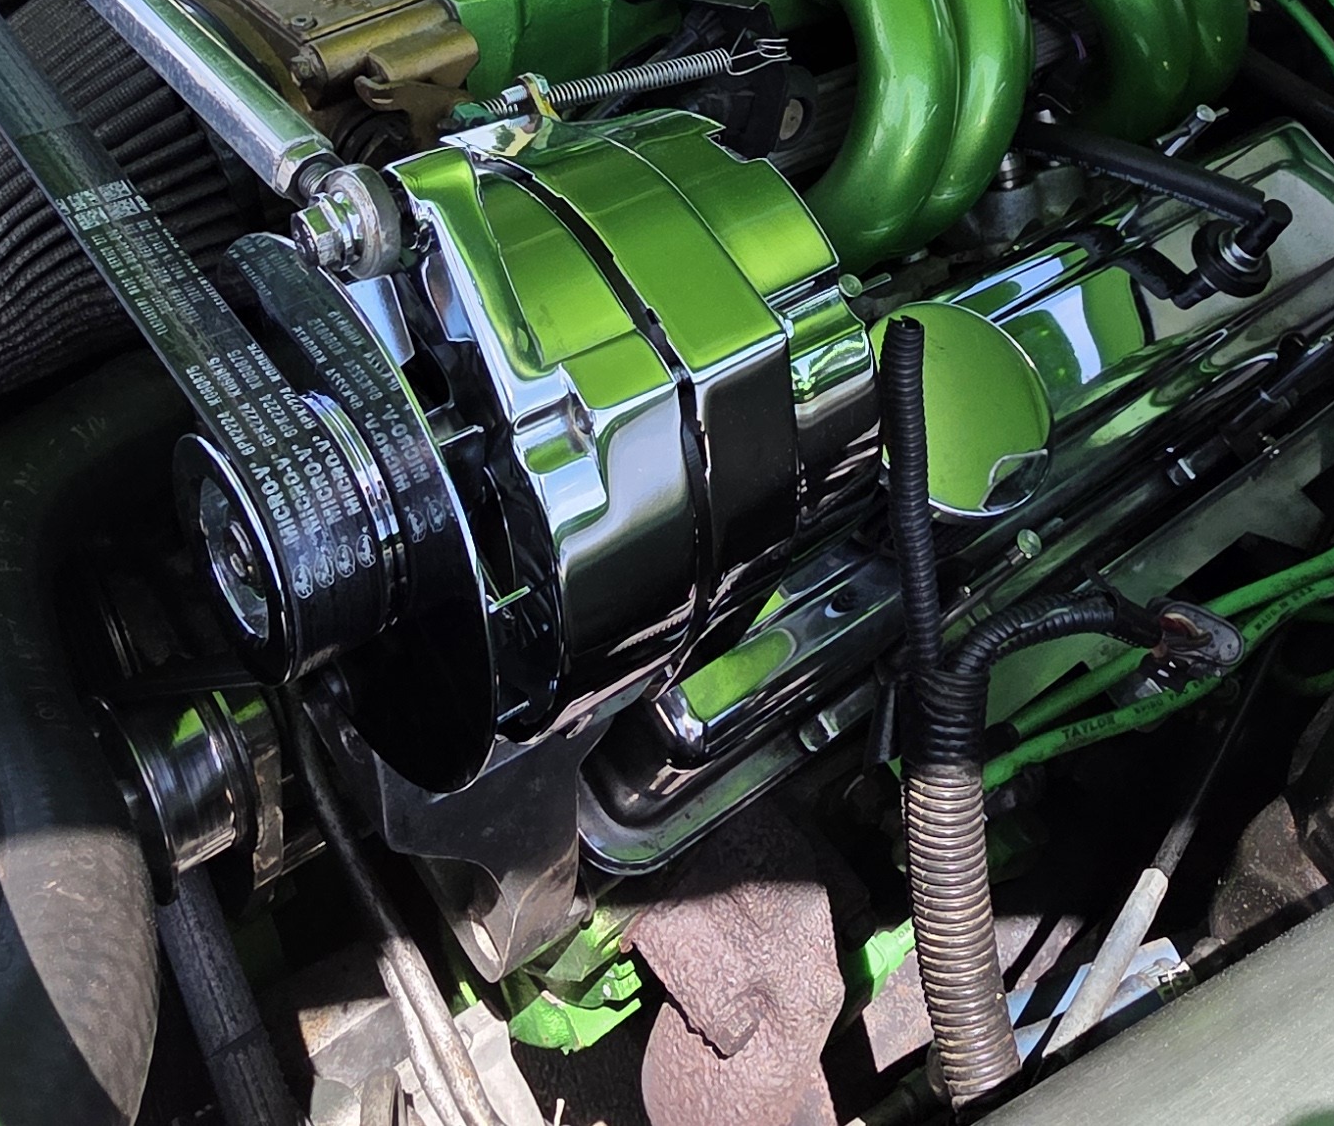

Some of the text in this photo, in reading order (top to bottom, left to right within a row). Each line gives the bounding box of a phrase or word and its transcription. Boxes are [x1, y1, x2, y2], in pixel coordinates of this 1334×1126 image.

[185, 363, 222, 407] K060875
[206, 355, 242, 399] K060875
[226, 346, 263, 390] K060875
[216, 409, 257, 457] 6PK2224
[237, 401, 276, 448] 6PK2224
[258, 392, 298, 439] 6PK2224
[1063, 712, 1117, 739] TAYLOR
